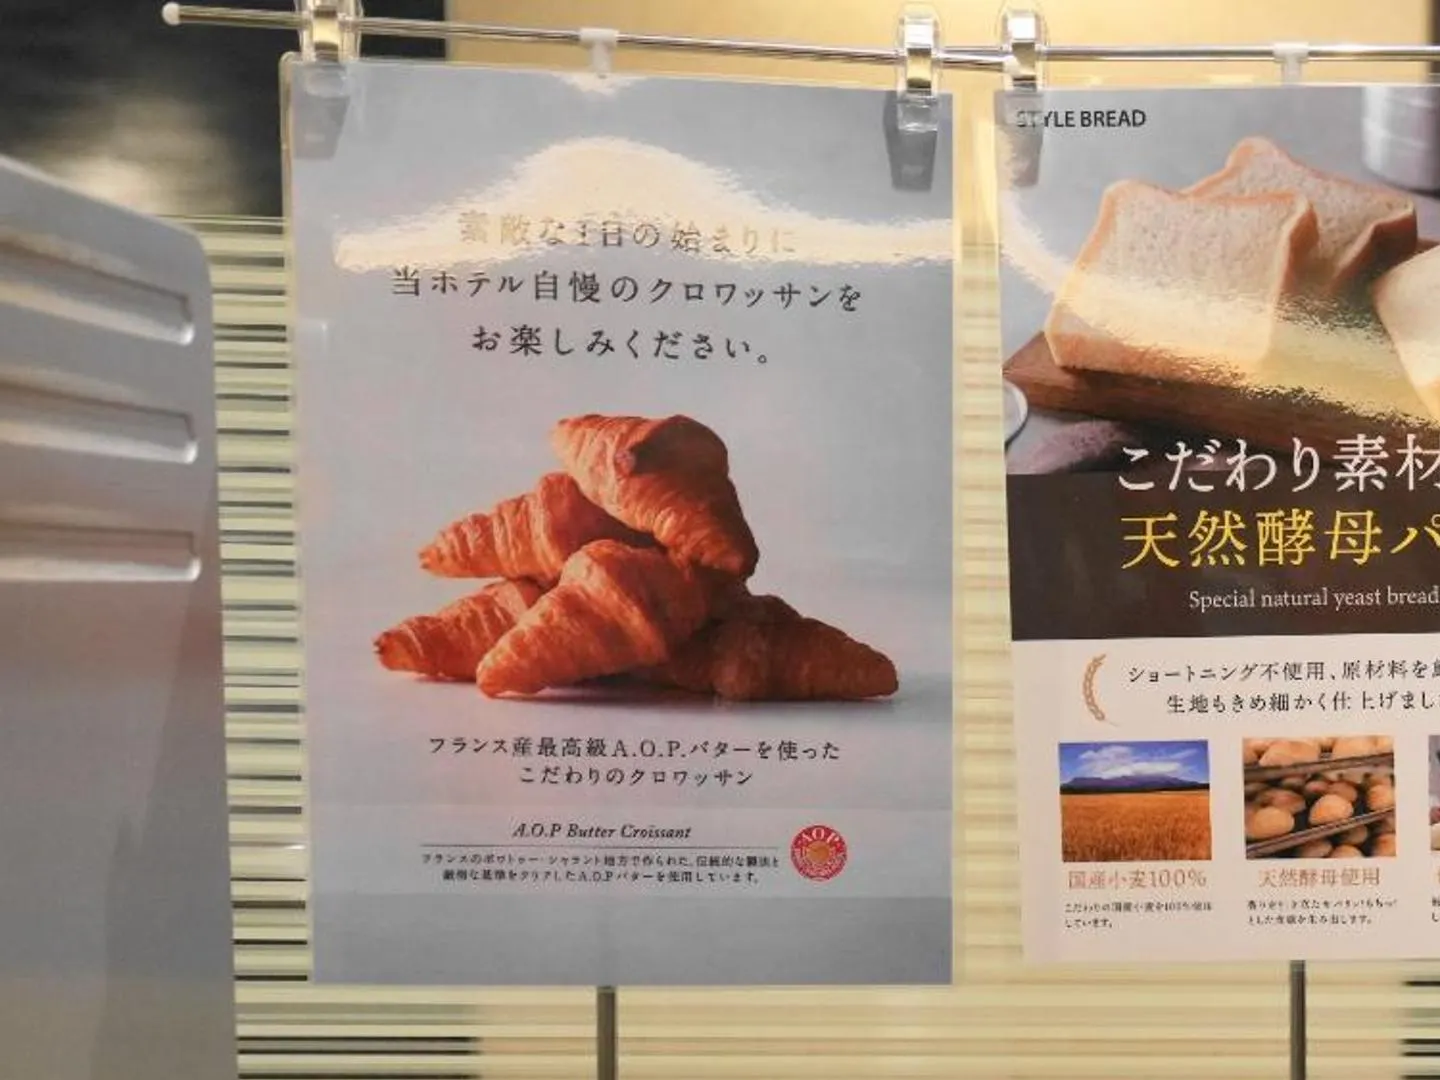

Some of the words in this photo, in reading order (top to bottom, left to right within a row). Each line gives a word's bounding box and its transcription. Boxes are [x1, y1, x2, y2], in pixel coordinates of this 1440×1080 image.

[1080, 109, 1147, 128] BREAD
[391, 269, 864, 313] 当ホテル自慢のクロワッサンを
[471, 324, 770, 366] お楽しみください。
[1189, 589, 1256, 613] Special
[1261, 587, 1328, 608] natural
[1333, 588, 1381, 612] yeast
[1387, 586, 1440, 606] bread
[428, 736, 841, 762] フランス産最高級A.O.P.バターを使った
[519, 765, 754, 787] こだわりのクロワッサン
[512, 824, 561, 840] A.O.P
[566, 824, 616, 841] Butter
[620, 824, 692, 840] Croissant
[1068, 869, 1208, 890] 国産小麦100%
[1258, 867, 1381, 887] 天然酵母使用
